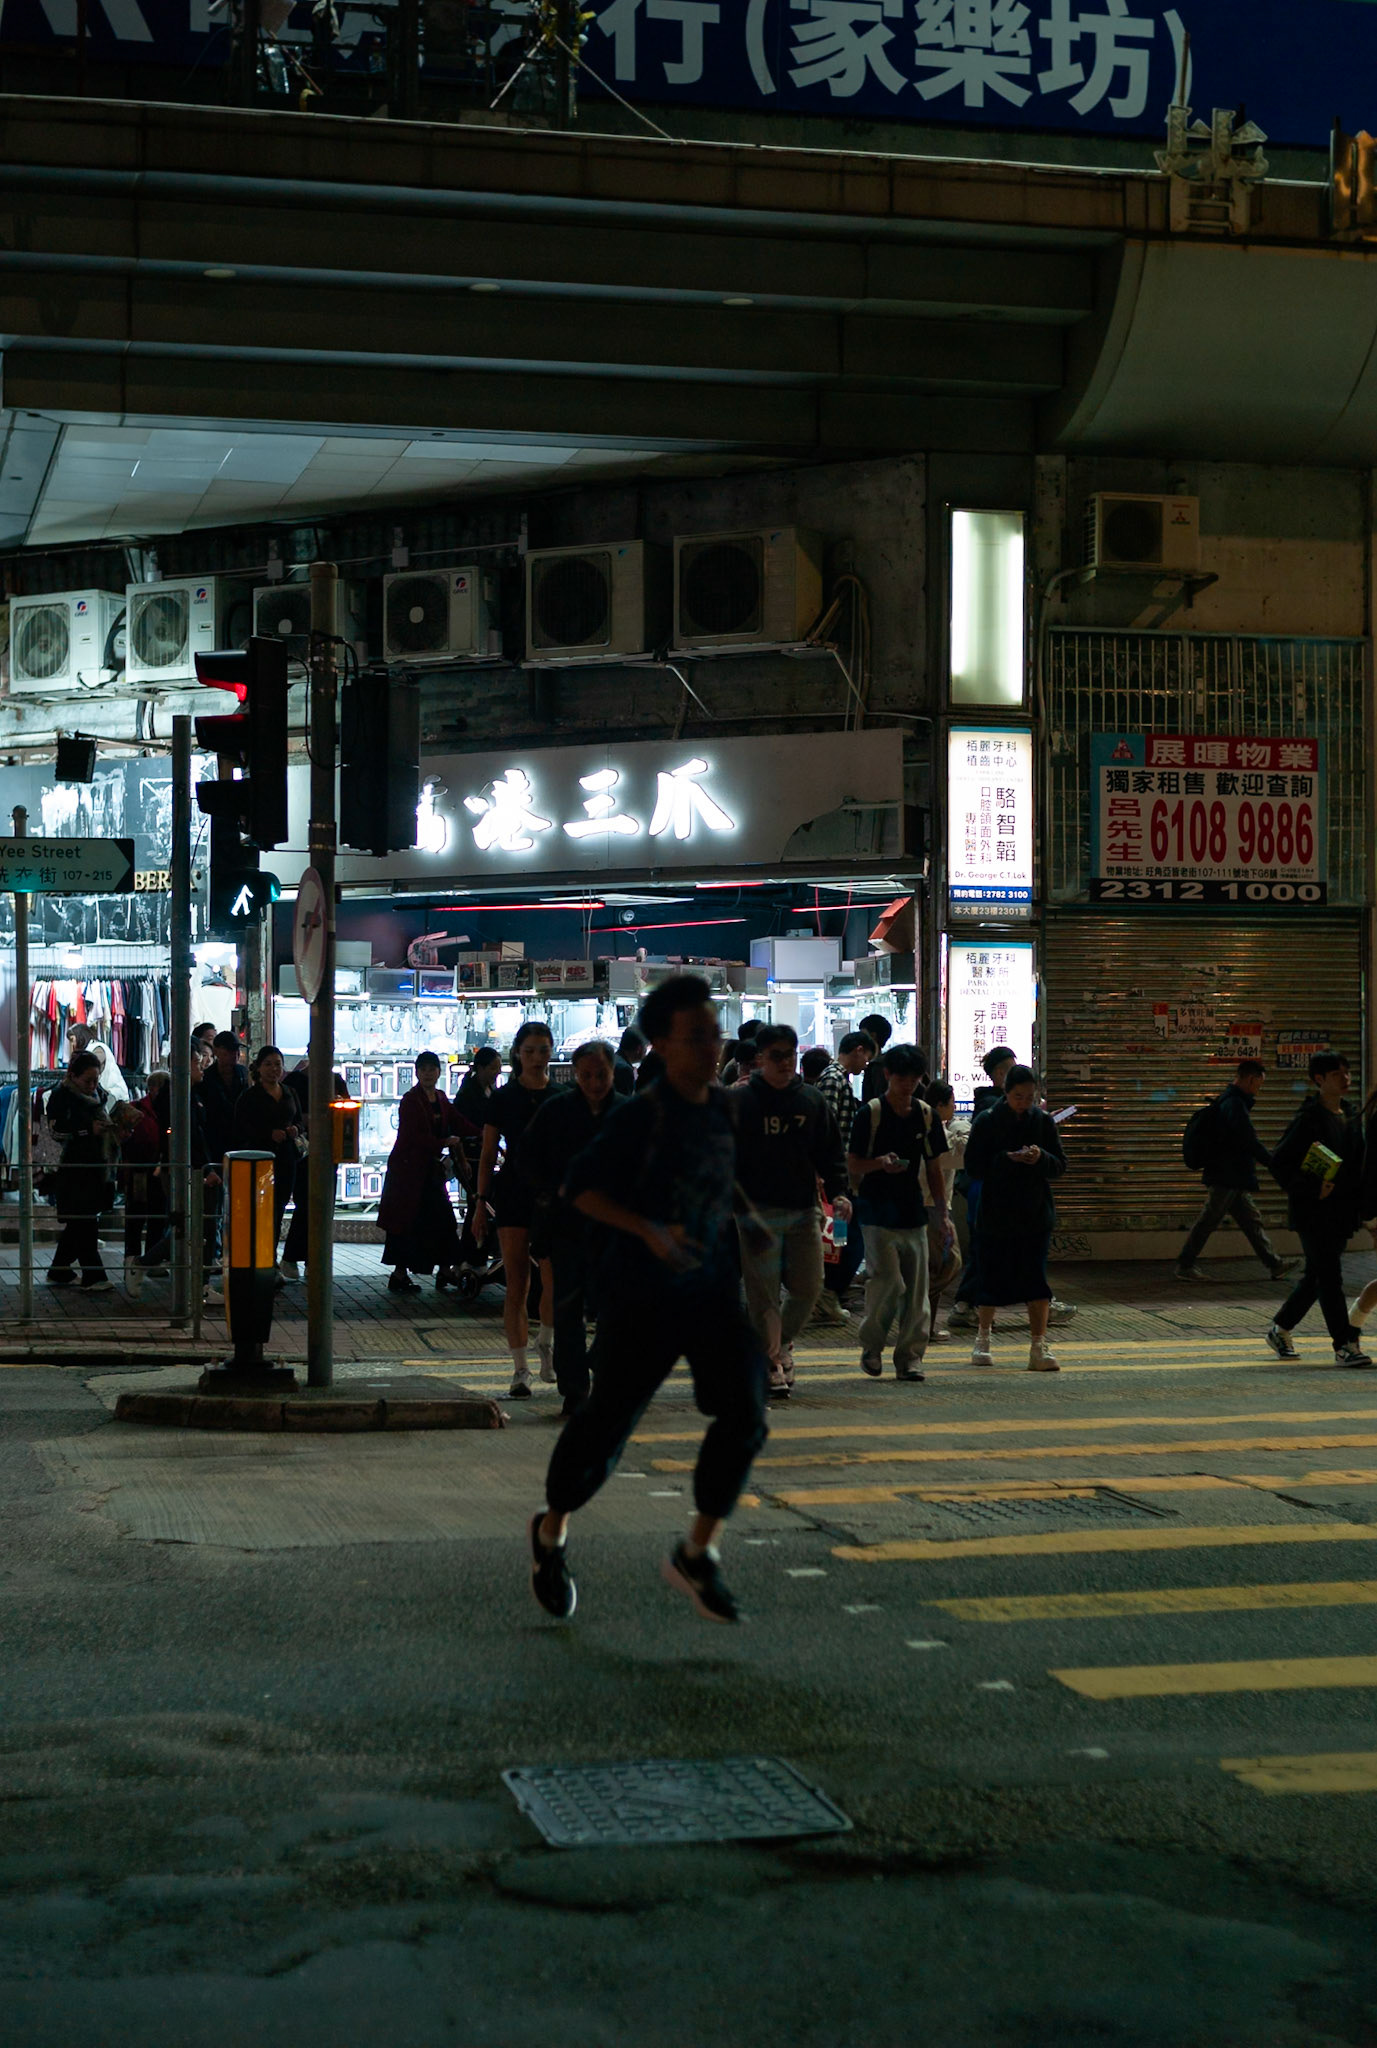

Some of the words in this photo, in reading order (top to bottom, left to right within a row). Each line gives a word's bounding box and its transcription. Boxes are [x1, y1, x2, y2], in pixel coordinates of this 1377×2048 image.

[966, 740, 1017, 753] 栢麗牙科
[1150, 739, 1314, 769] 展暉物業
[966, 755, 1017, 768] 植齒中心
[1106, 770, 1206, 796] 獨家租售
[1215, 771, 1313, 798] 歡迎查詢
[1106, 798, 1143, 862] 呂先生
[1150, 799, 1227, 863] 6108
[1238, 801, 1313, 865] 9886
[32, 844, 80, 858] Street
[968, 871, 998, 880] George
[1008, 890, 1028, 899] 3100
[1100, 881, 1205, 899] 2312
[1220, 883, 1321, 900] 1000
[966, 952, 1016, 965] 栢麗牙科
[967, 979, 988, 987] PARK
[954, 1072, 968, 1082] Dr.
